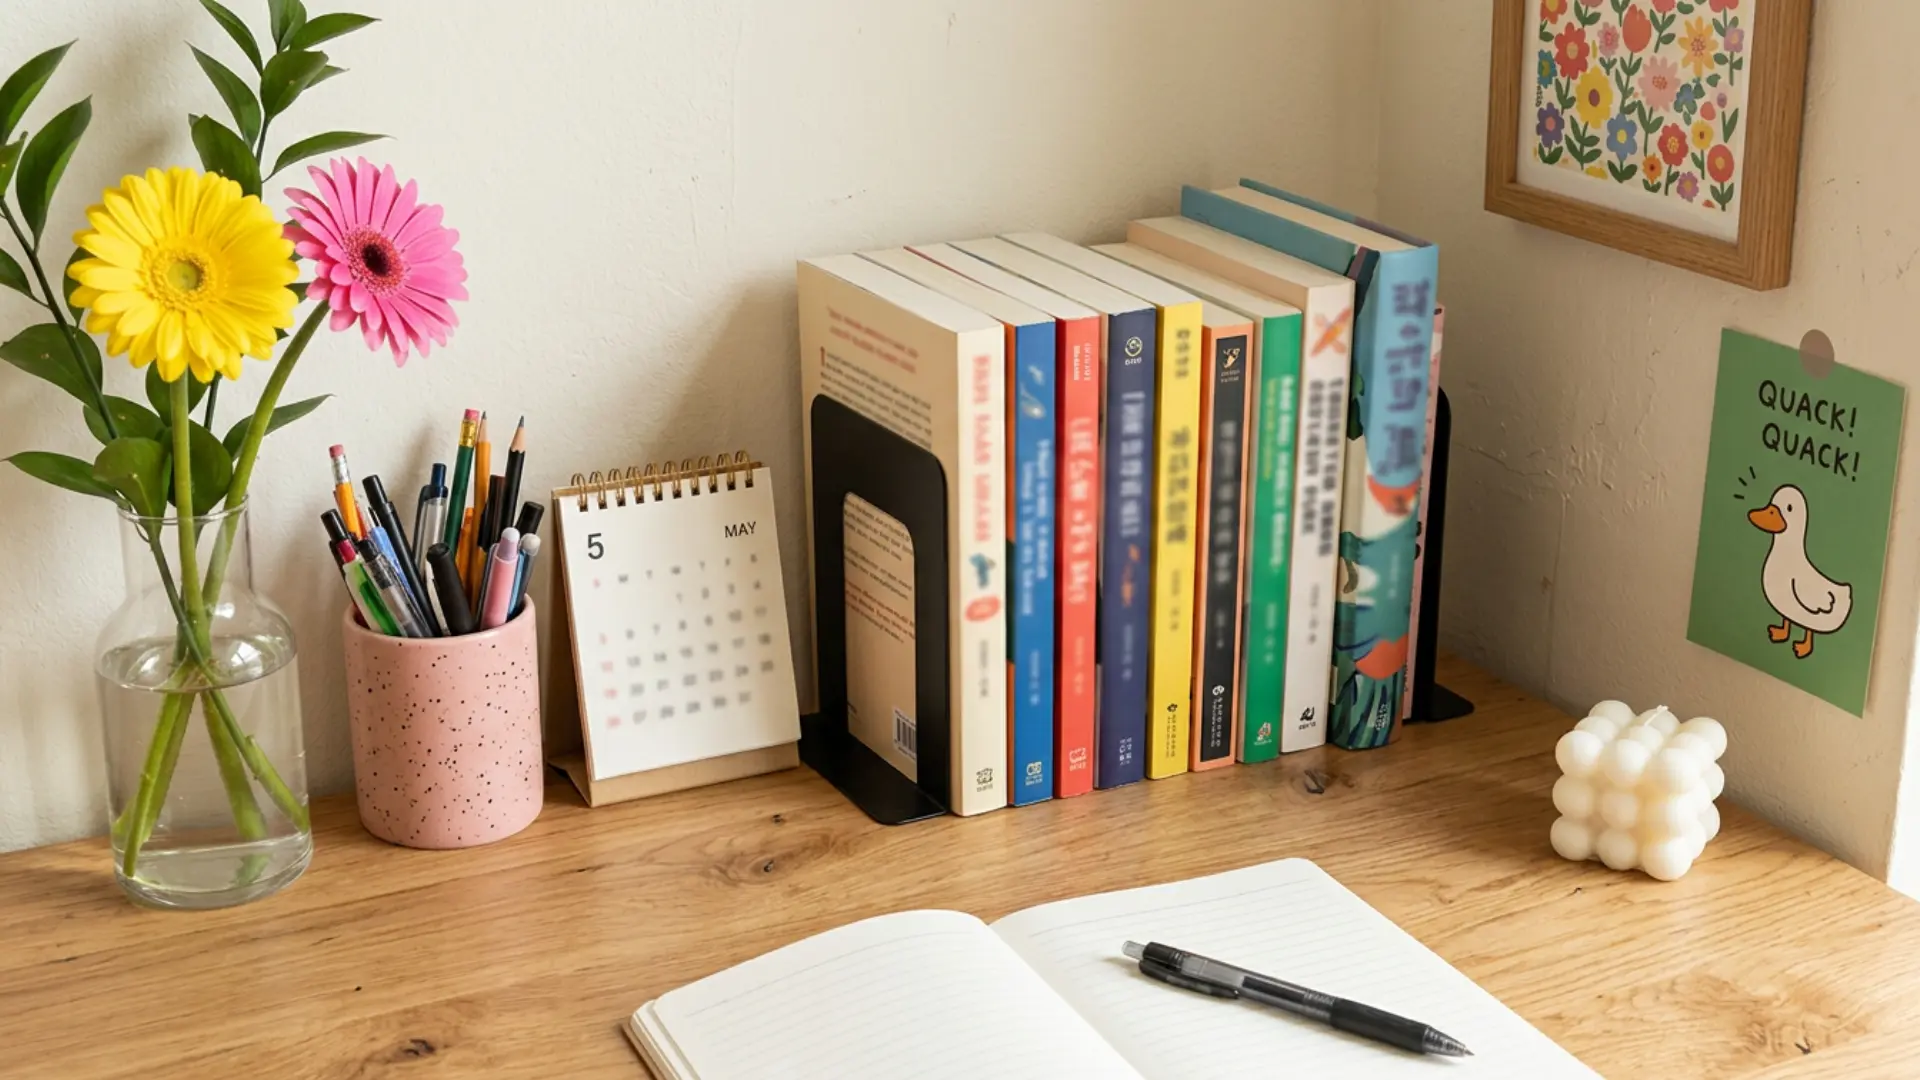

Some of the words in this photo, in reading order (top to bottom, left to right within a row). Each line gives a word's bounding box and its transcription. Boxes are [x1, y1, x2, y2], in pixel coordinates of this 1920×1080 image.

[1758, 379, 1857, 438] QUACK!
[1762, 422, 1860, 482] QUACK!
[587, 532, 604, 560] 5
[724, 521, 757, 538] MAY
